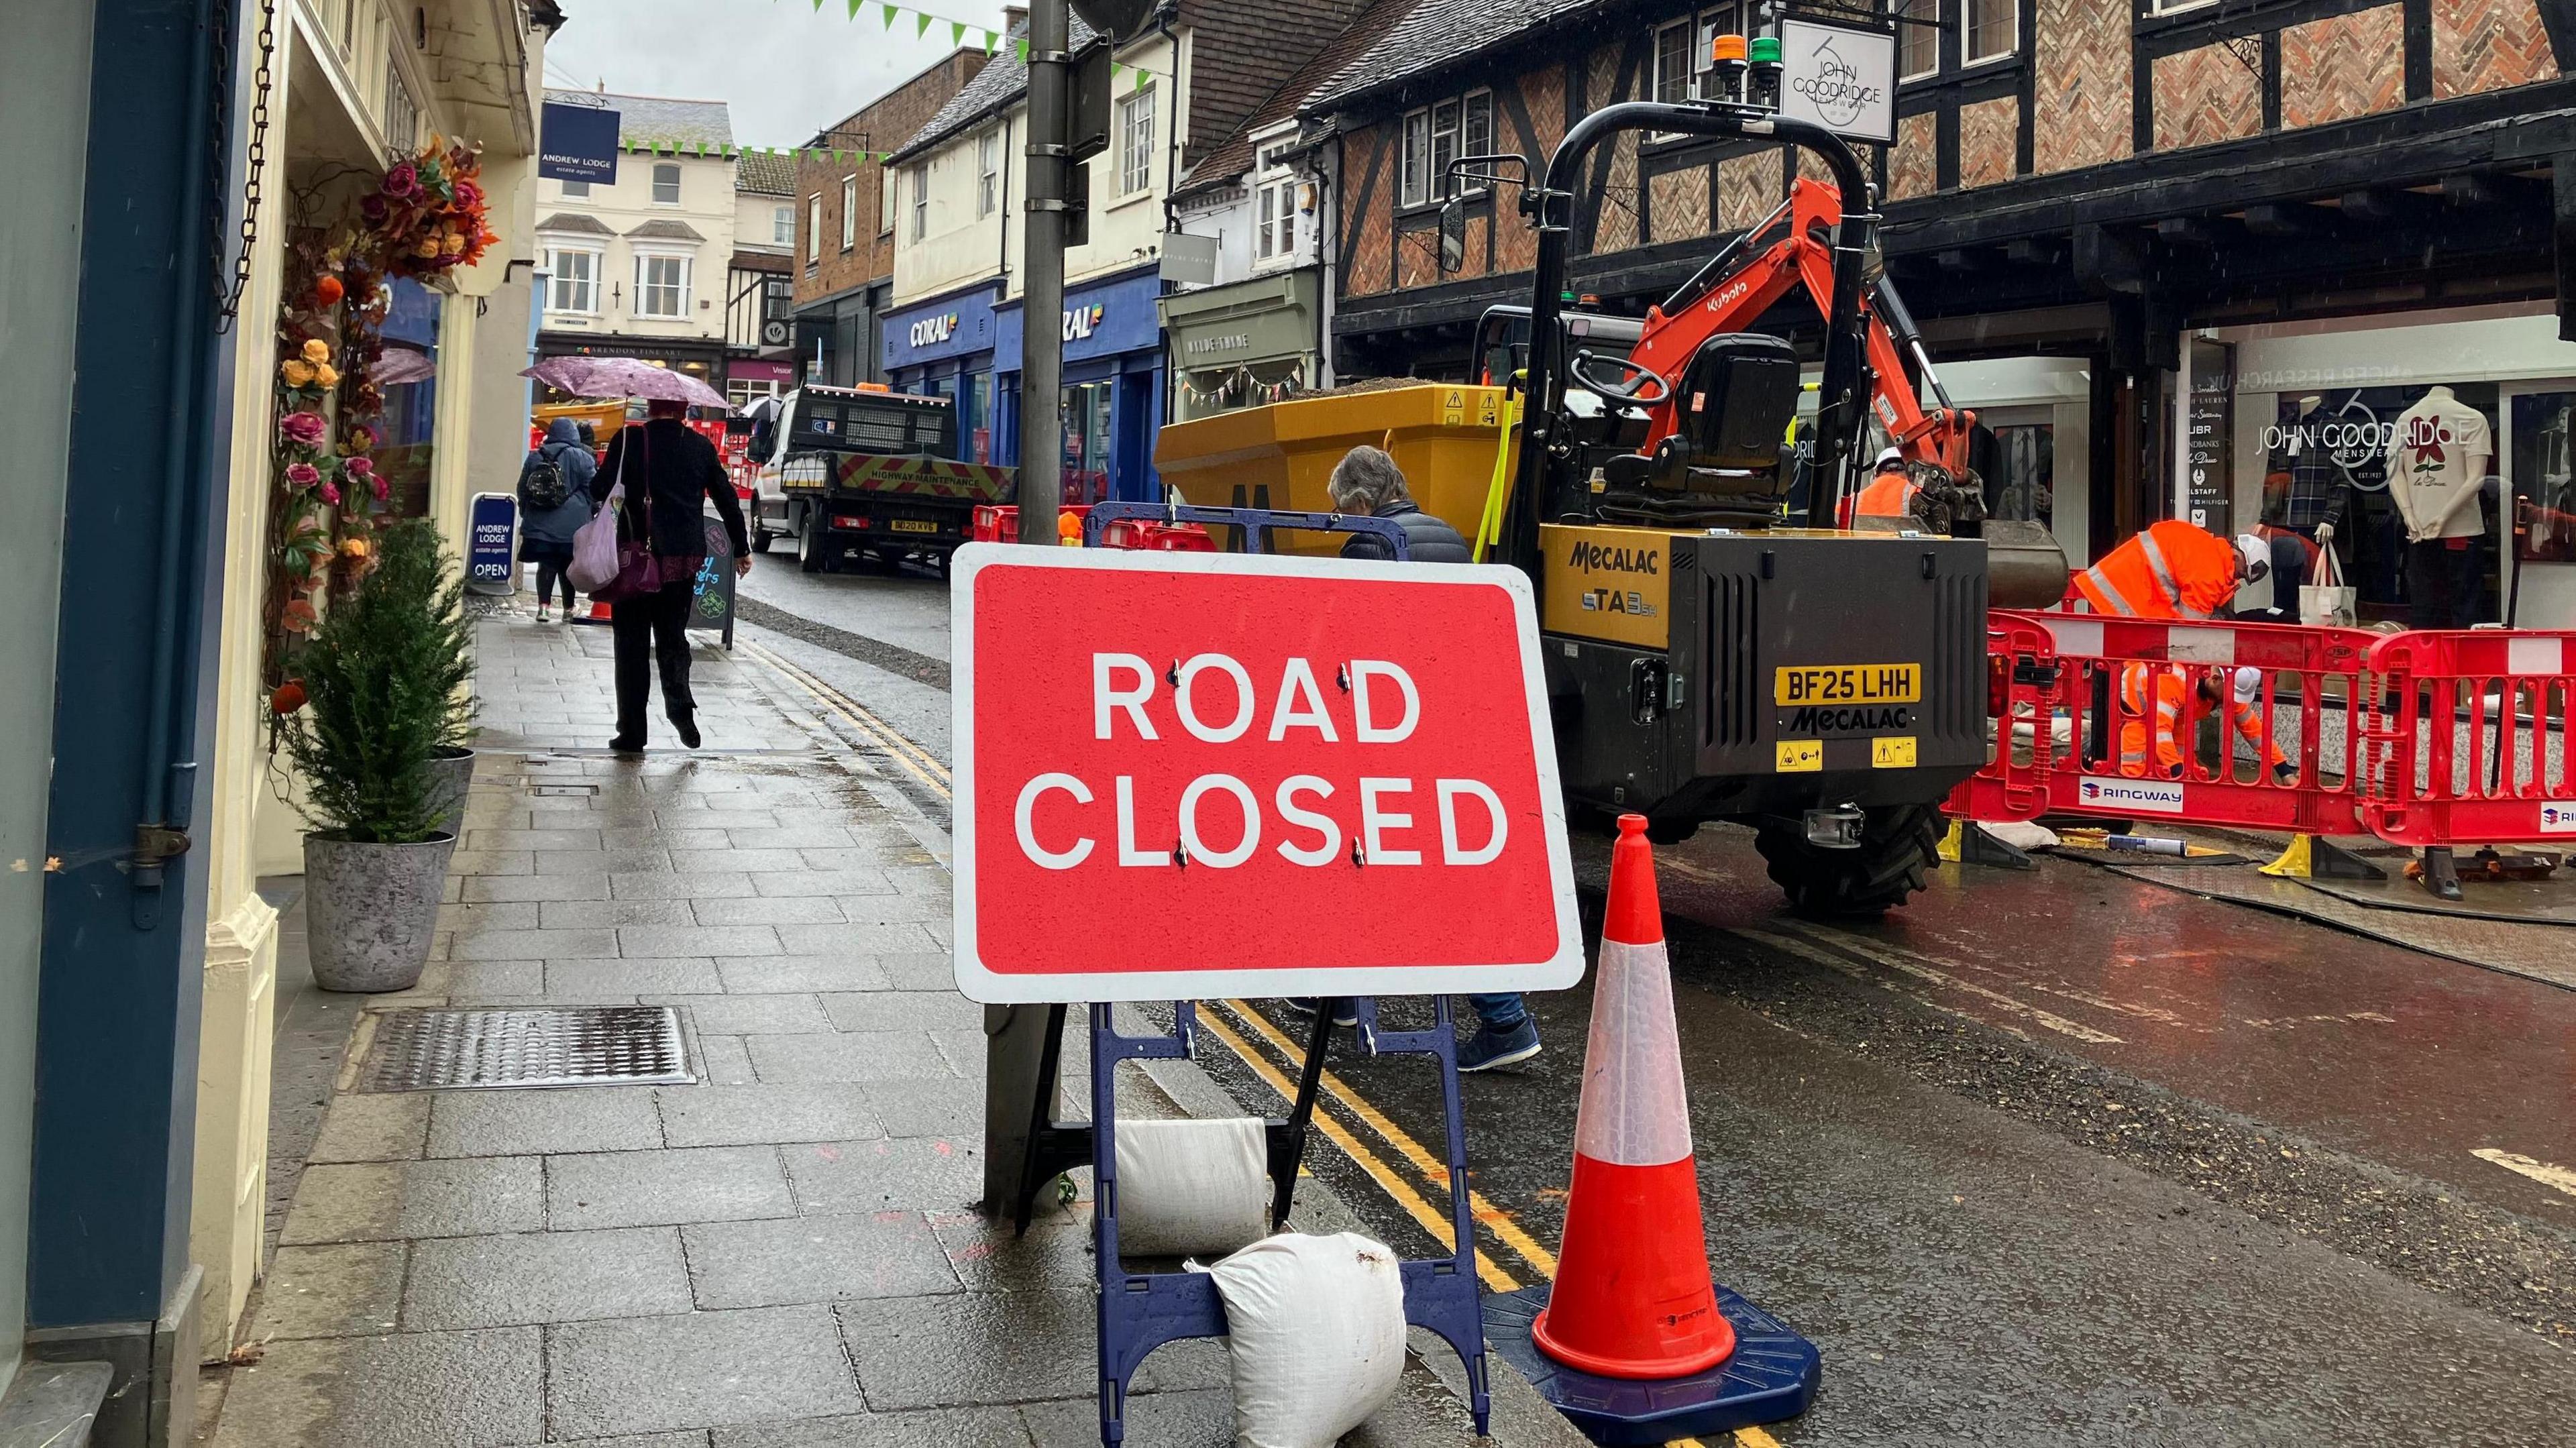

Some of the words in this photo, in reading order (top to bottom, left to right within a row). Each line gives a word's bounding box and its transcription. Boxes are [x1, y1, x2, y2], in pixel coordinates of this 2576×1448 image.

[1817, 61, 1857, 80] JOHN
[1793, 77, 1880, 103] GOODRIDGE
[542, 154, 580, 164] ANDREW
[583, 158, 611, 168] LODGE
[1707, 282, 1748, 312] Kubota
[910, 314, 950, 347] CORAL
[1063, 306, 1091, 341] RAL
[591, 346, 635, 355] ARENDON
[640, 347, 661, 355] FINE
[2256, 425, 2314, 455] JOHN
[2322, 421, 2473, 447] GOODRIDGE
[871, 470, 914, 482] HIGHWAY
[915, 474, 980, 487] MAINTENANCE
[476, 524, 510, 534] ANDREW
[480, 534, 505, 543] LODGE
[475, 563, 507, 576] OPEN
[1788, 671, 1854, 700] BF25
[1862, 668, 1910, 698] LHH
[1093, 653, 1420, 743] ROAD
[2104, 789, 2182, 802] RINGWAY
[1014, 773, 1508, 870] CLOSED
[2562, 813, 2576, 822] RI
